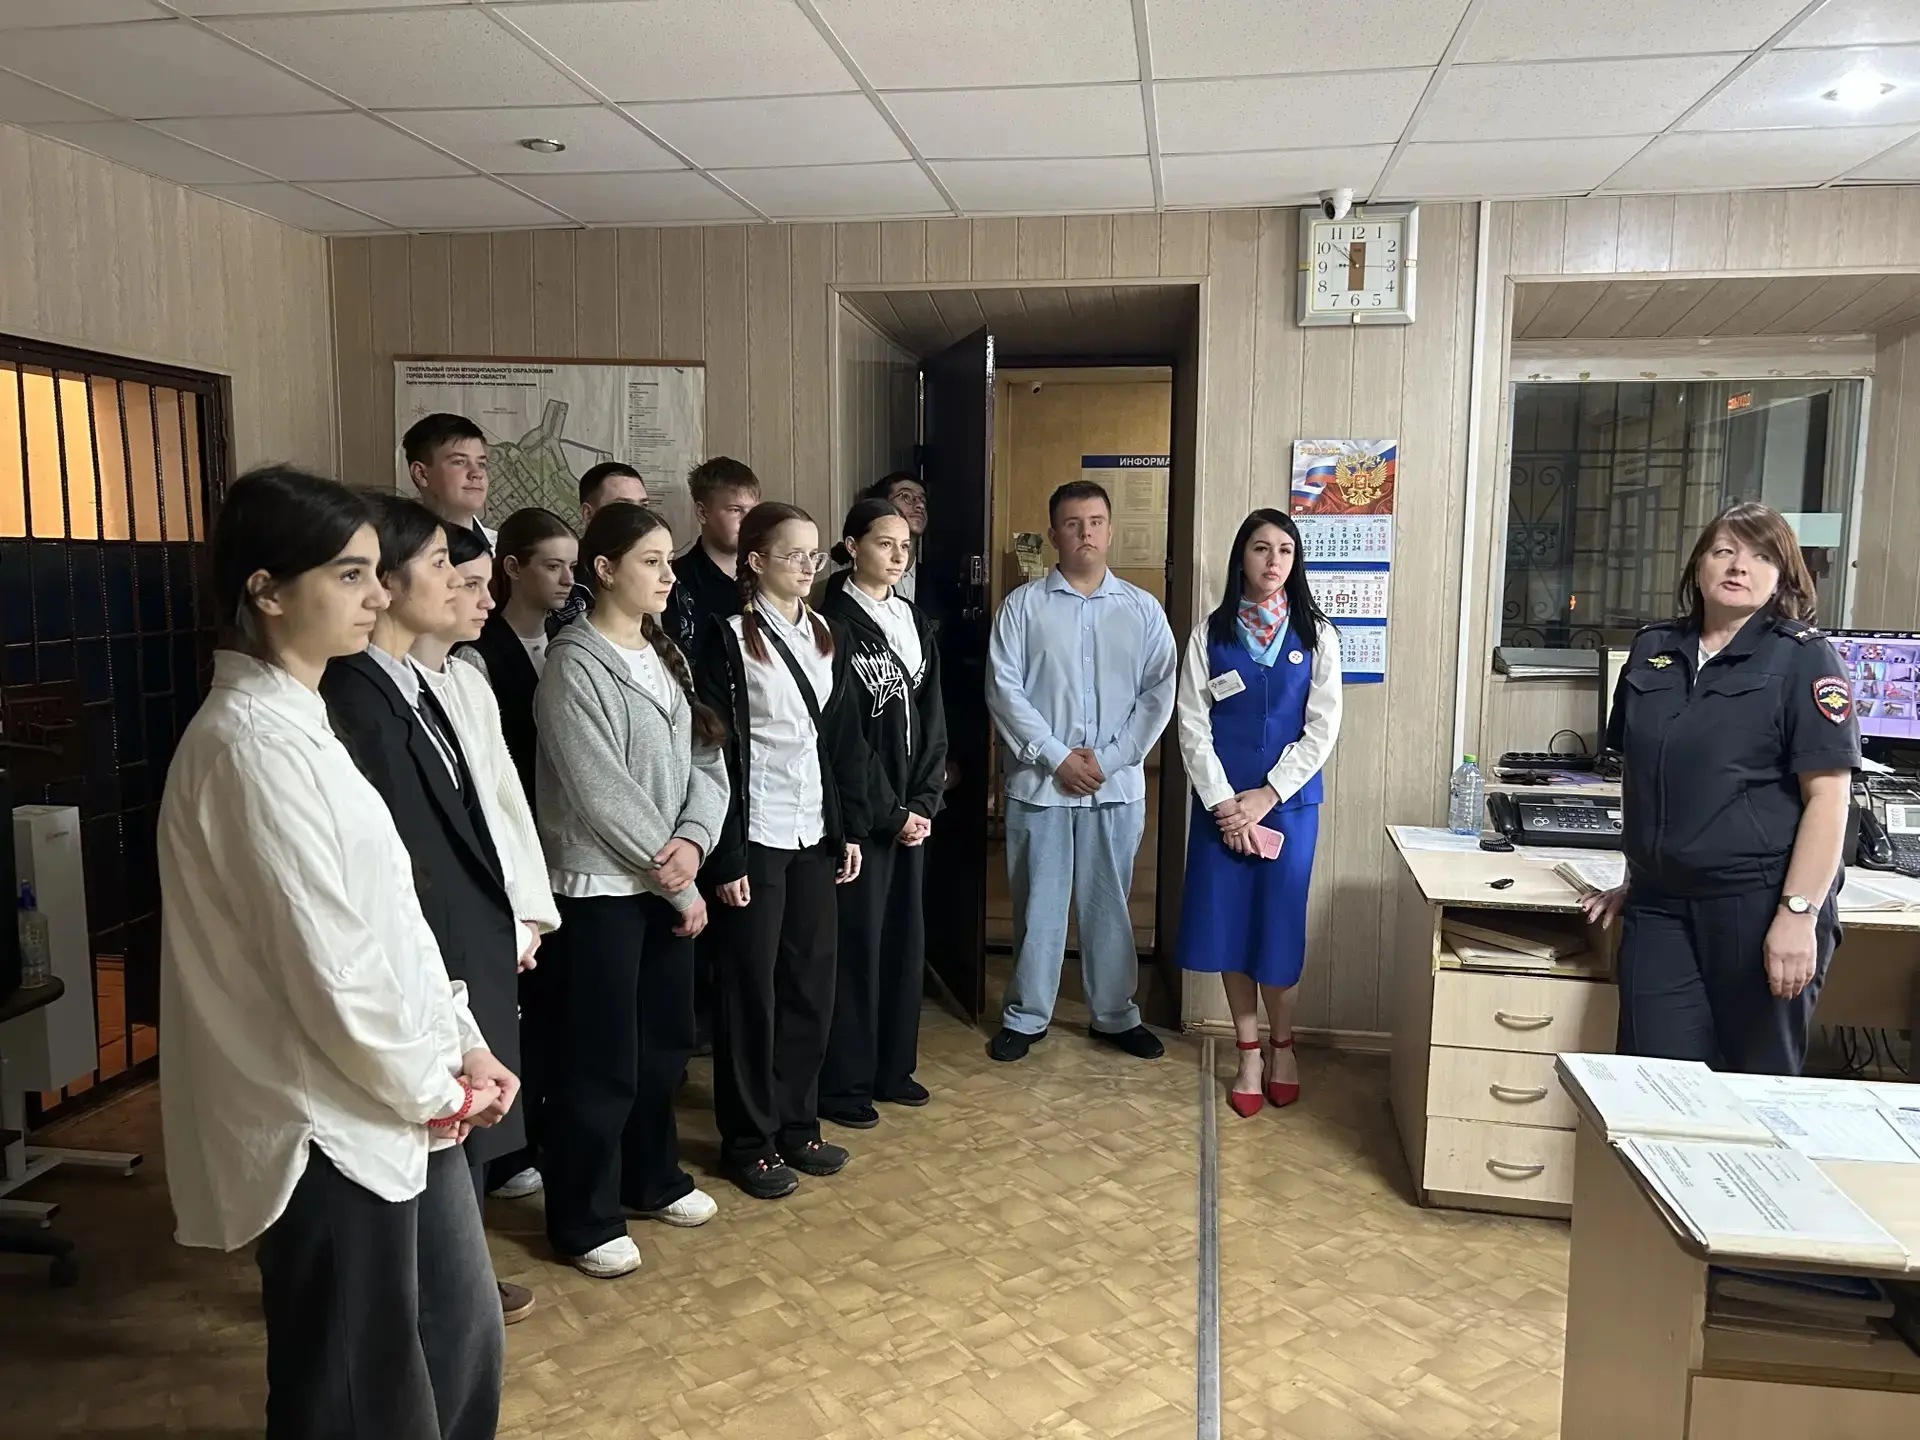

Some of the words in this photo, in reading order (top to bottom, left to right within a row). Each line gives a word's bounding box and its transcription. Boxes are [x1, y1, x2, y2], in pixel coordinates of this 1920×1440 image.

[1331, 227, 1342, 240] 11
[1352, 226, 1365, 240] 12
[1377, 226, 1382, 238] 1
[1317, 242, 1331, 254] 10
[1387, 240, 1396, 252] 2
[1318, 261, 1328, 274] 9
[1386, 260, 1396, 272] 3
[1318, 280, 1328, 292] 8
[1385, 280, 1395, 292] 4
[1331, 294, 1339, 307] 7
[1350, 294, 1360, 306] 6
[1372, 294, 1381, 306] 5
[1120, 457, 1170, 466] ИНФОРМА
